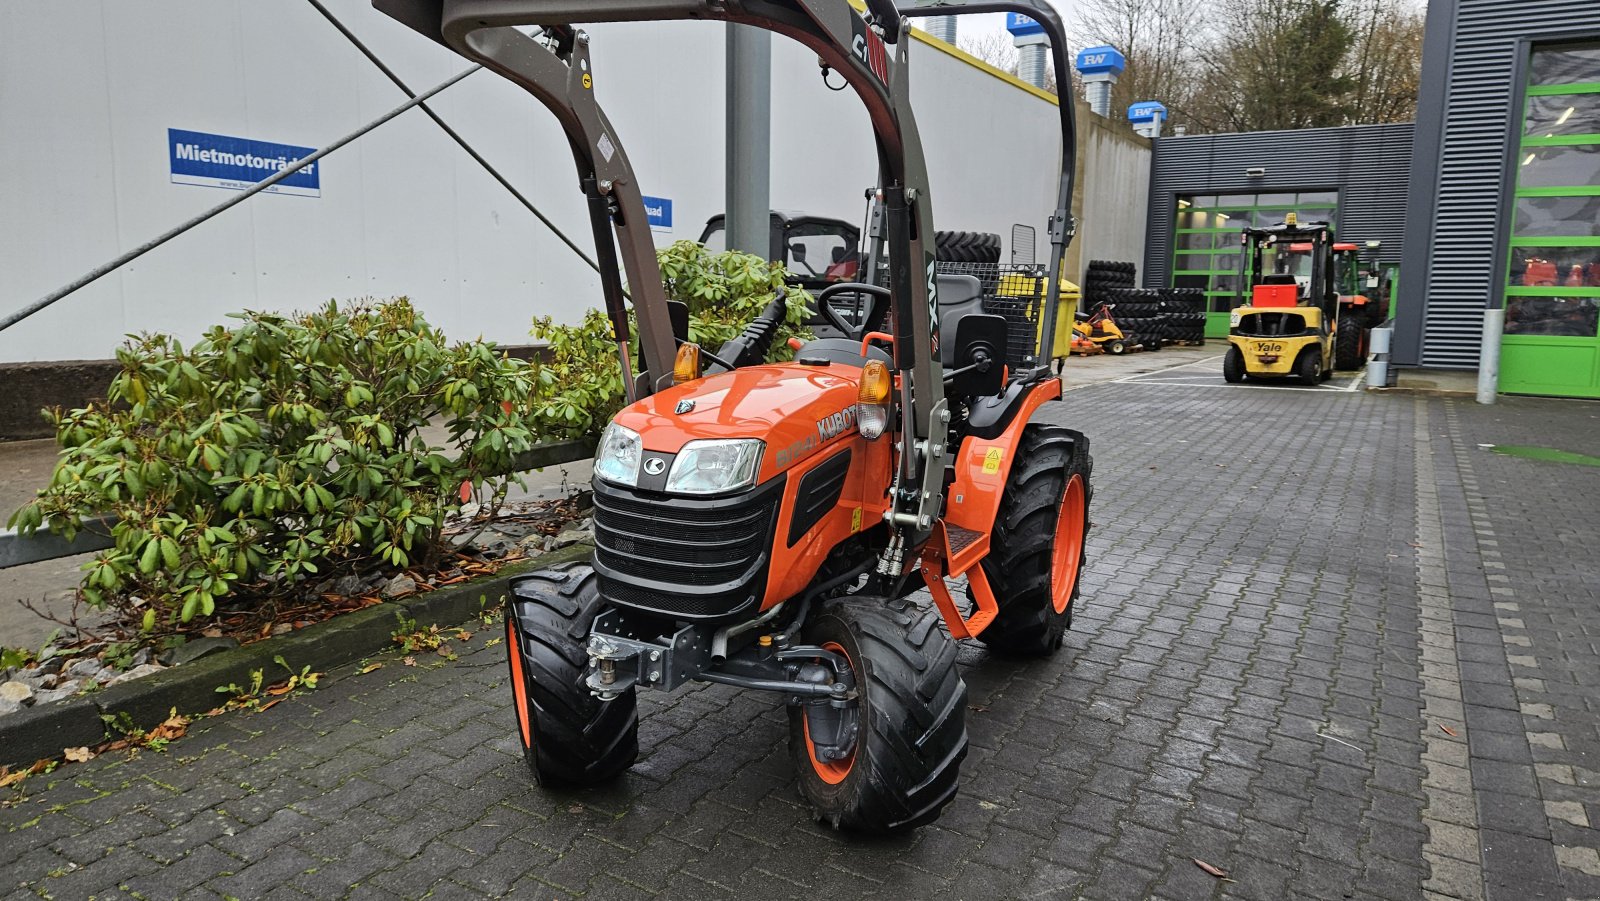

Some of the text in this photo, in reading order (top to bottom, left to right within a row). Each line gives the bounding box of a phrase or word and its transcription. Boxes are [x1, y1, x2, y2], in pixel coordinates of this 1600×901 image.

[852, 34, 868, 62] C1
[644, 202, 662, 217] uad
[926, 259, 938, 333] MX
[1257, 342, 1282, 352] Yale
[816, 404, 857, 443] KUBOT
